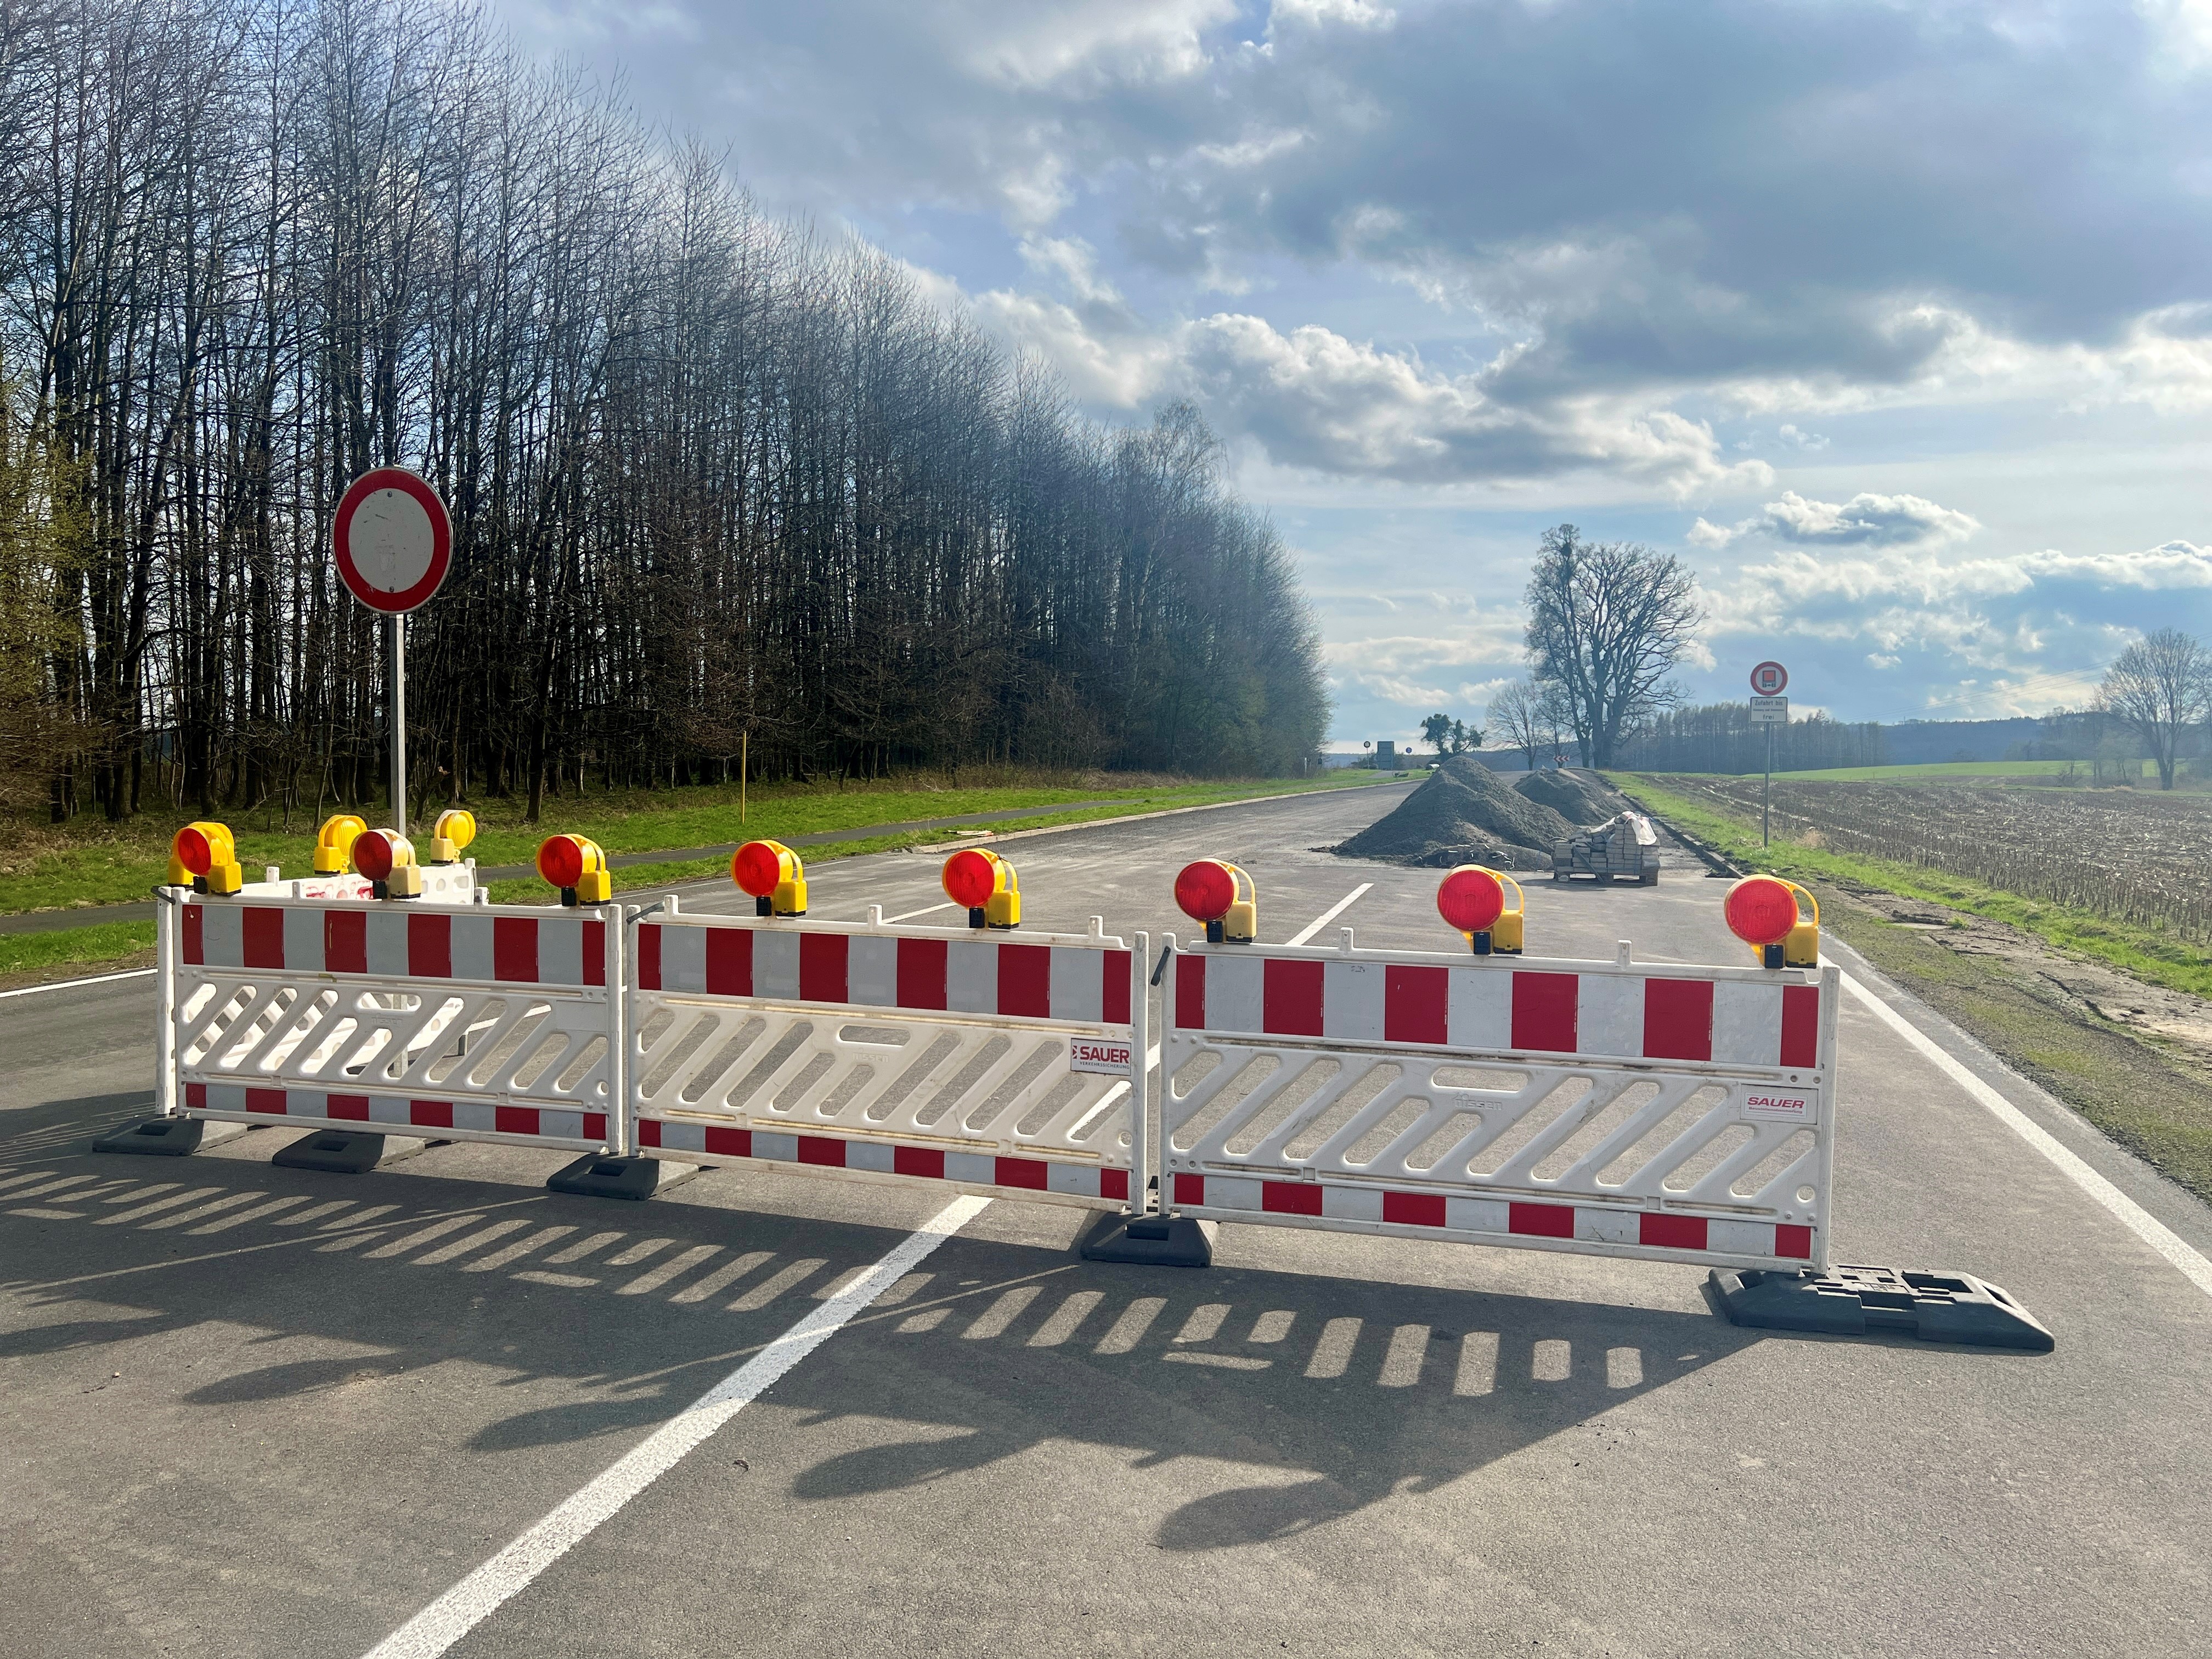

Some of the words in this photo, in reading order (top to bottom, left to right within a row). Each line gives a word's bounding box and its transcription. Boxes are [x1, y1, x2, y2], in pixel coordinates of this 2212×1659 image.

[1080, 1046, 1130, 1064] SAUER
[1079, 1061, 1130, 1069] VERKEHRSSICHERUNG
[1455, 1094, 1502, 1110] nissen
[1747, 1097, 1804, 1109] SAUER
